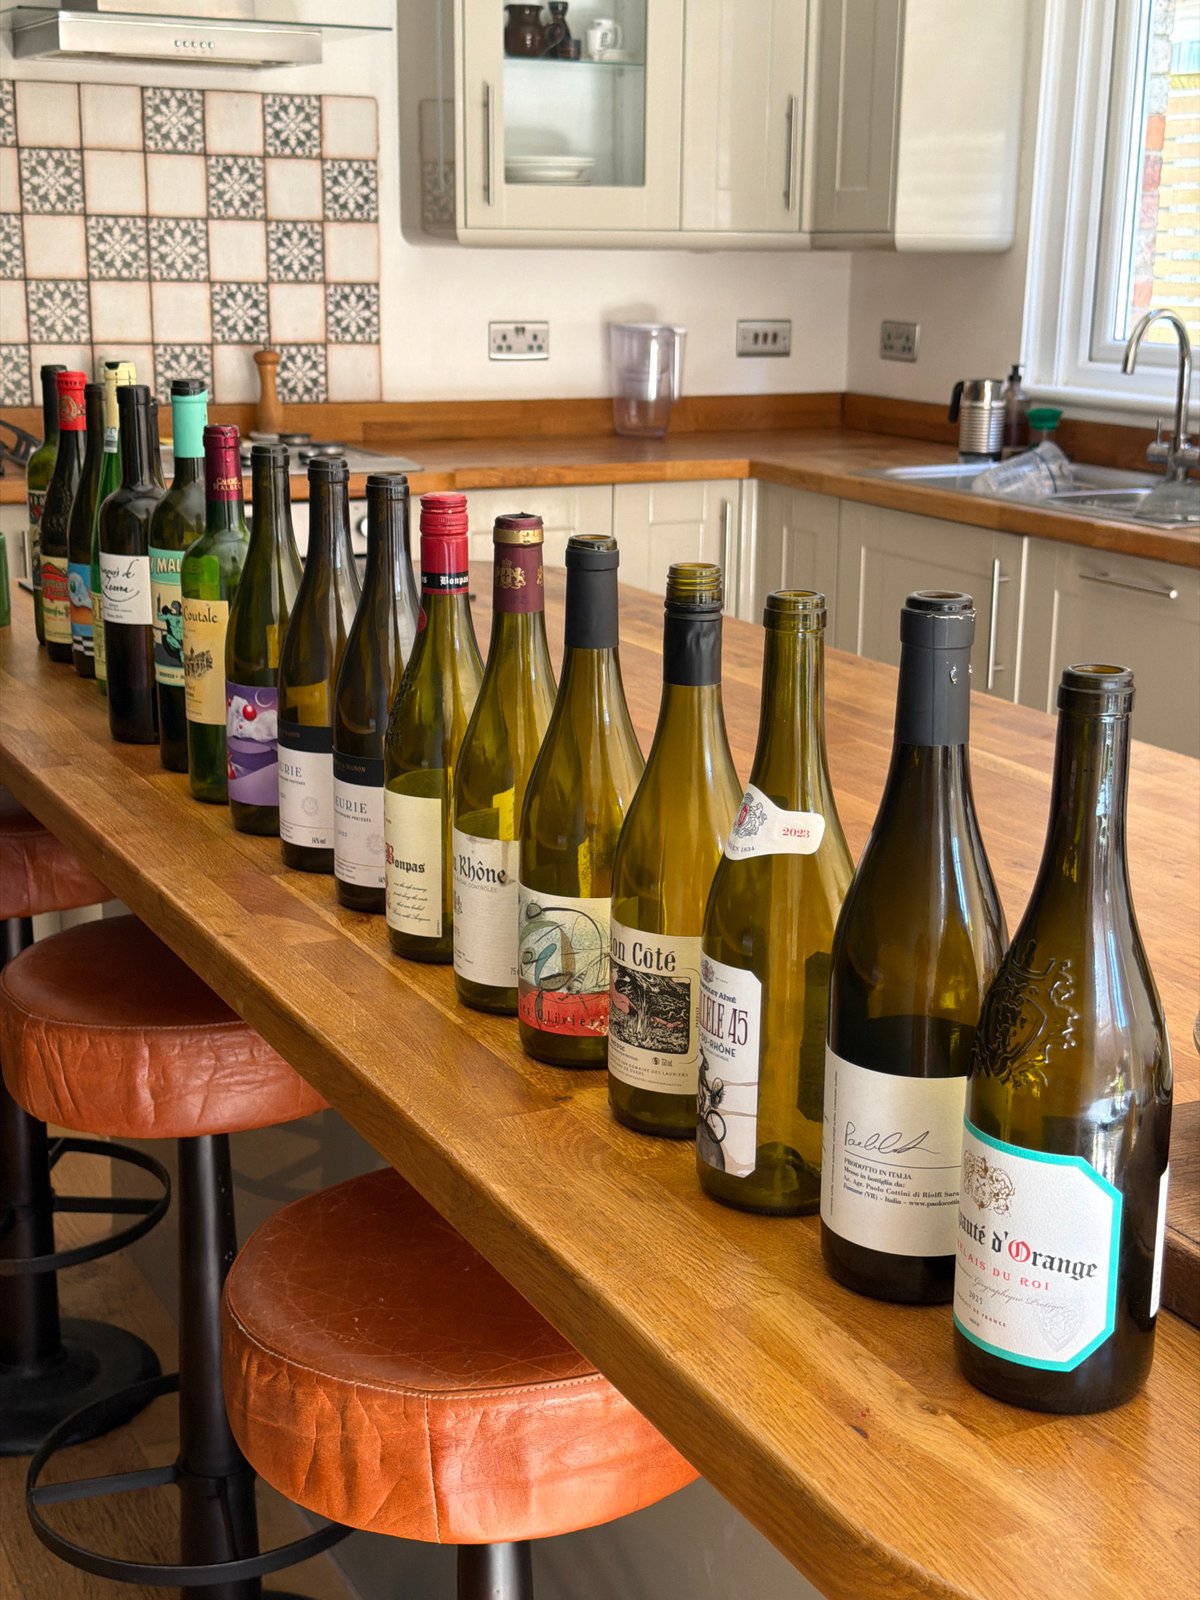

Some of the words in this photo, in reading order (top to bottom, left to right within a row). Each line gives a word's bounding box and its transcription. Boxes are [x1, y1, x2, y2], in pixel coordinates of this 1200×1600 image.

[782, 827, 810, 838] 2023
[459, 854, 506, 884] Rhône
[611, 937, 626, 963] on
[632, 942, 676, 973] Côté
[728, 1007, 749, 1046] 45
[844, 1157, 878, 1175] PRODOTTO
[879, 1169, 888, 1177] IN
[888, 1171, 912, 1180] ITALIA
[885, 1188, 910, 1197] Cottini
[992, 1267, 1011, 1282] DU
[1019, 1276, 1049, 1291] ROI
